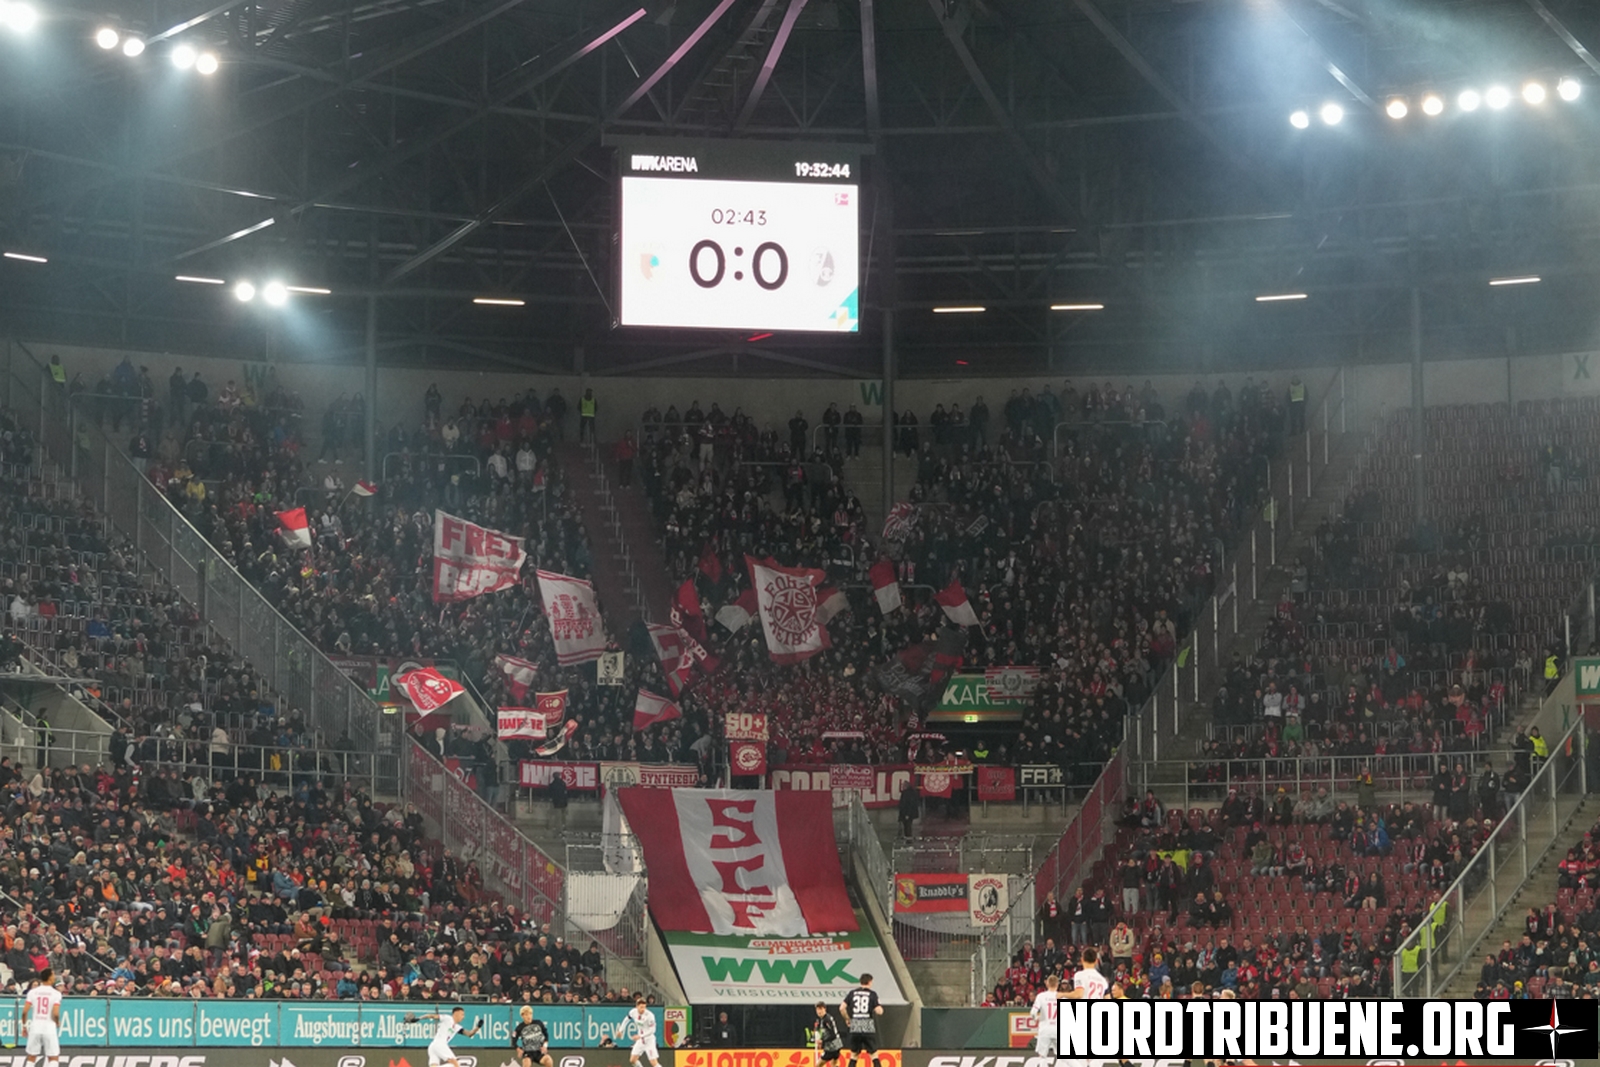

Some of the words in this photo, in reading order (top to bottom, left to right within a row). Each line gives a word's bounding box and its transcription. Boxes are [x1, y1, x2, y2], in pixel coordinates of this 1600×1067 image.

[794, 162, 850, 178] 19:32:44
[711, 208, 767, 226] 02:43
[688, 239, 789, 291] 0:0
[1573, 354, 1591, 380] X
[860, 382, 883, 406] W
[701, 956, 860, 985] WWK
[1088, 981, 1104, 999] 23
[37, 996, 50, 1015] 19
[852, 995, 870, 1014] 38
[58, 1008, 107, 1038] Alles
[113, 1015, 152, 1038] was
[159, 1015, 192, 1038] uns
[200, 1008, 271, 1046] bewegt
[294, 1013, 374, 1044] Augsburger
[553, 1022, 582, 1041] uns
